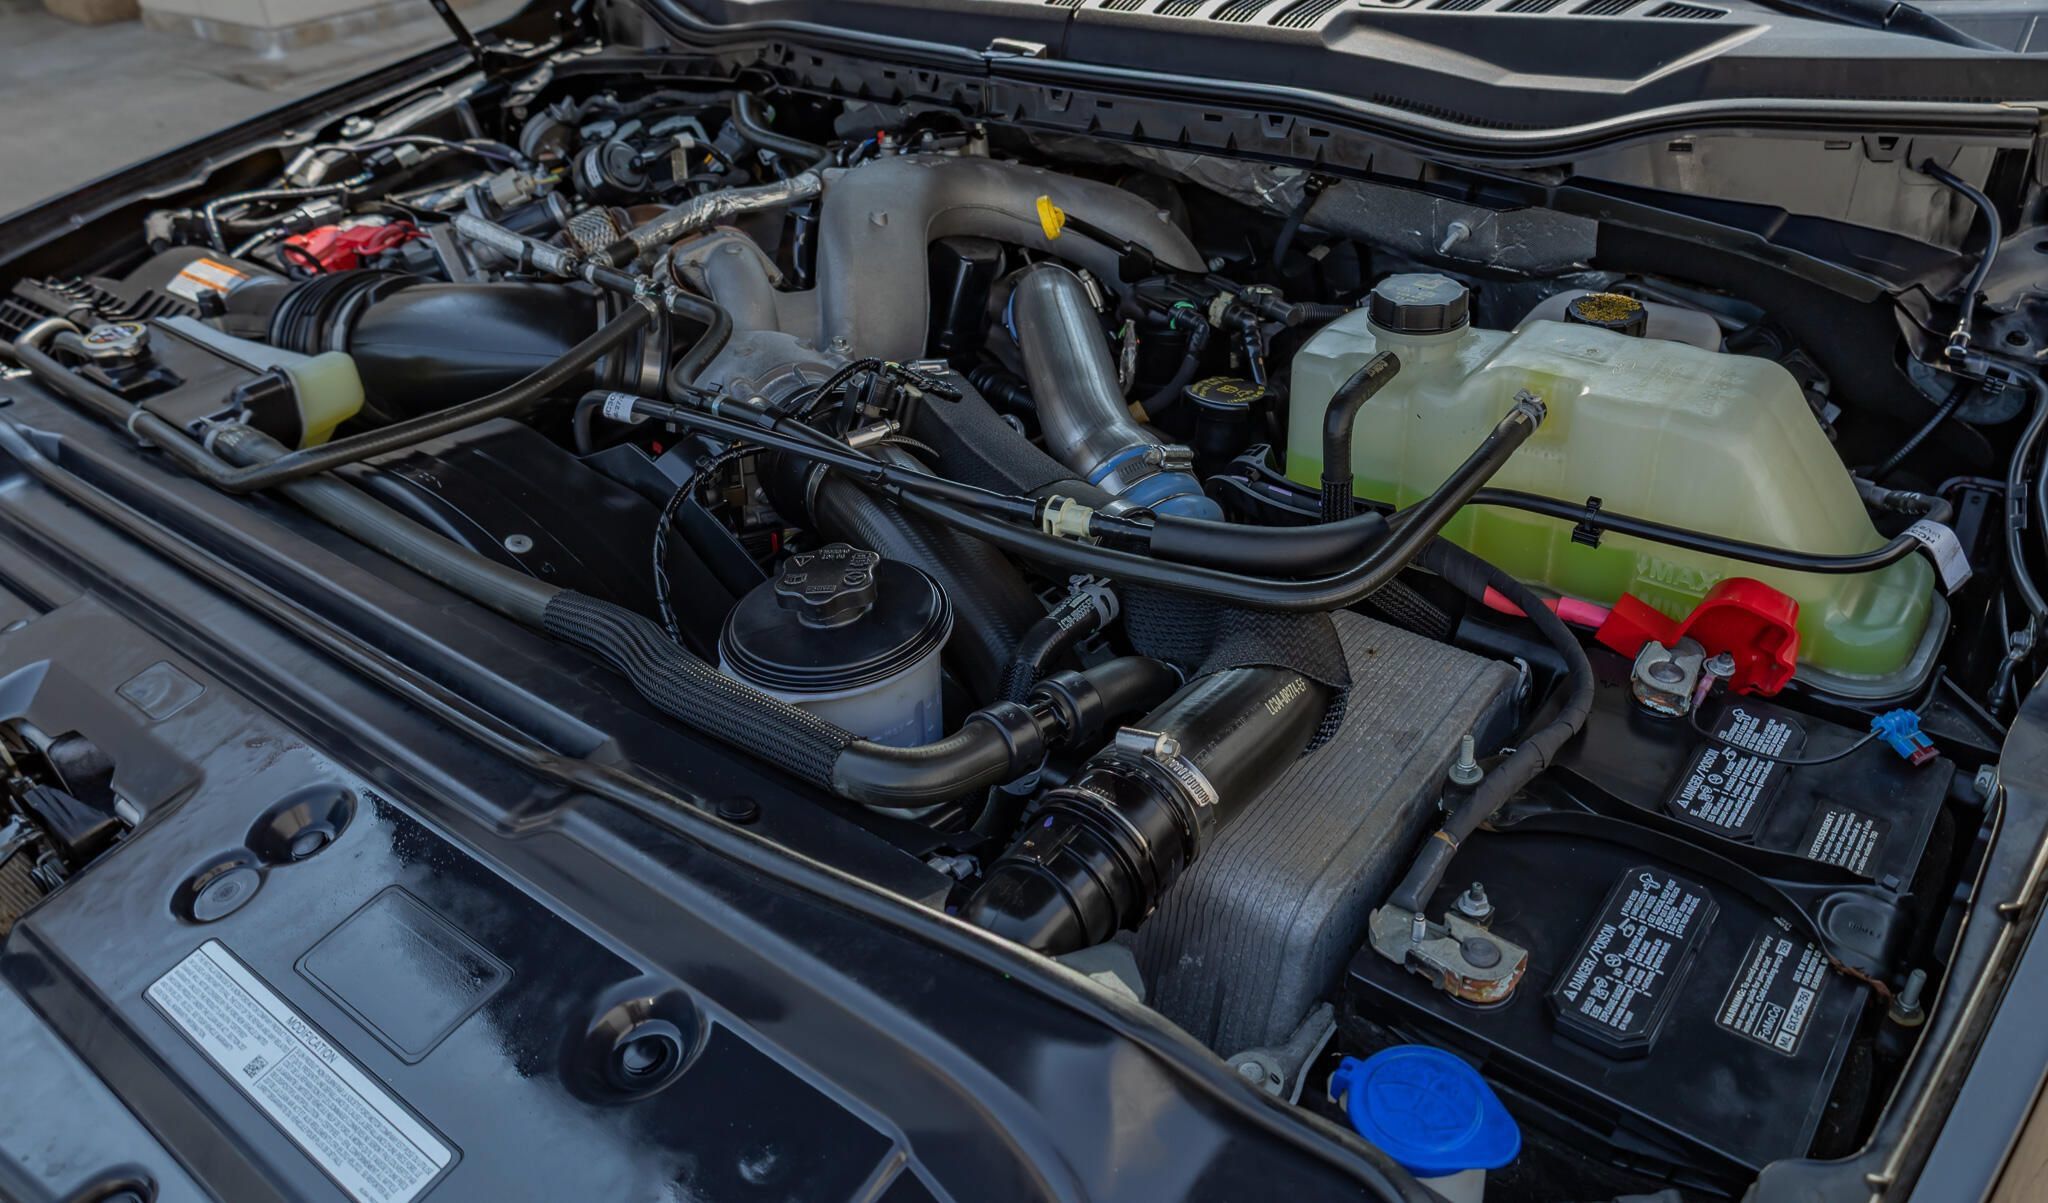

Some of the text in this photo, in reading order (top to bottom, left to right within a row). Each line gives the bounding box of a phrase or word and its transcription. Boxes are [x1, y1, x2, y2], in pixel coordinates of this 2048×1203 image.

[1650, 557, 1721, 592] MAX
[1723, 989, 1746, 1024] WARNING:
[1757, 1005, 1781, 1040] FoMoCo
[1779, 991, 1810, 1048] ML BXT-65-750
[287, 1017, 337, 1063] MODIFICATION
